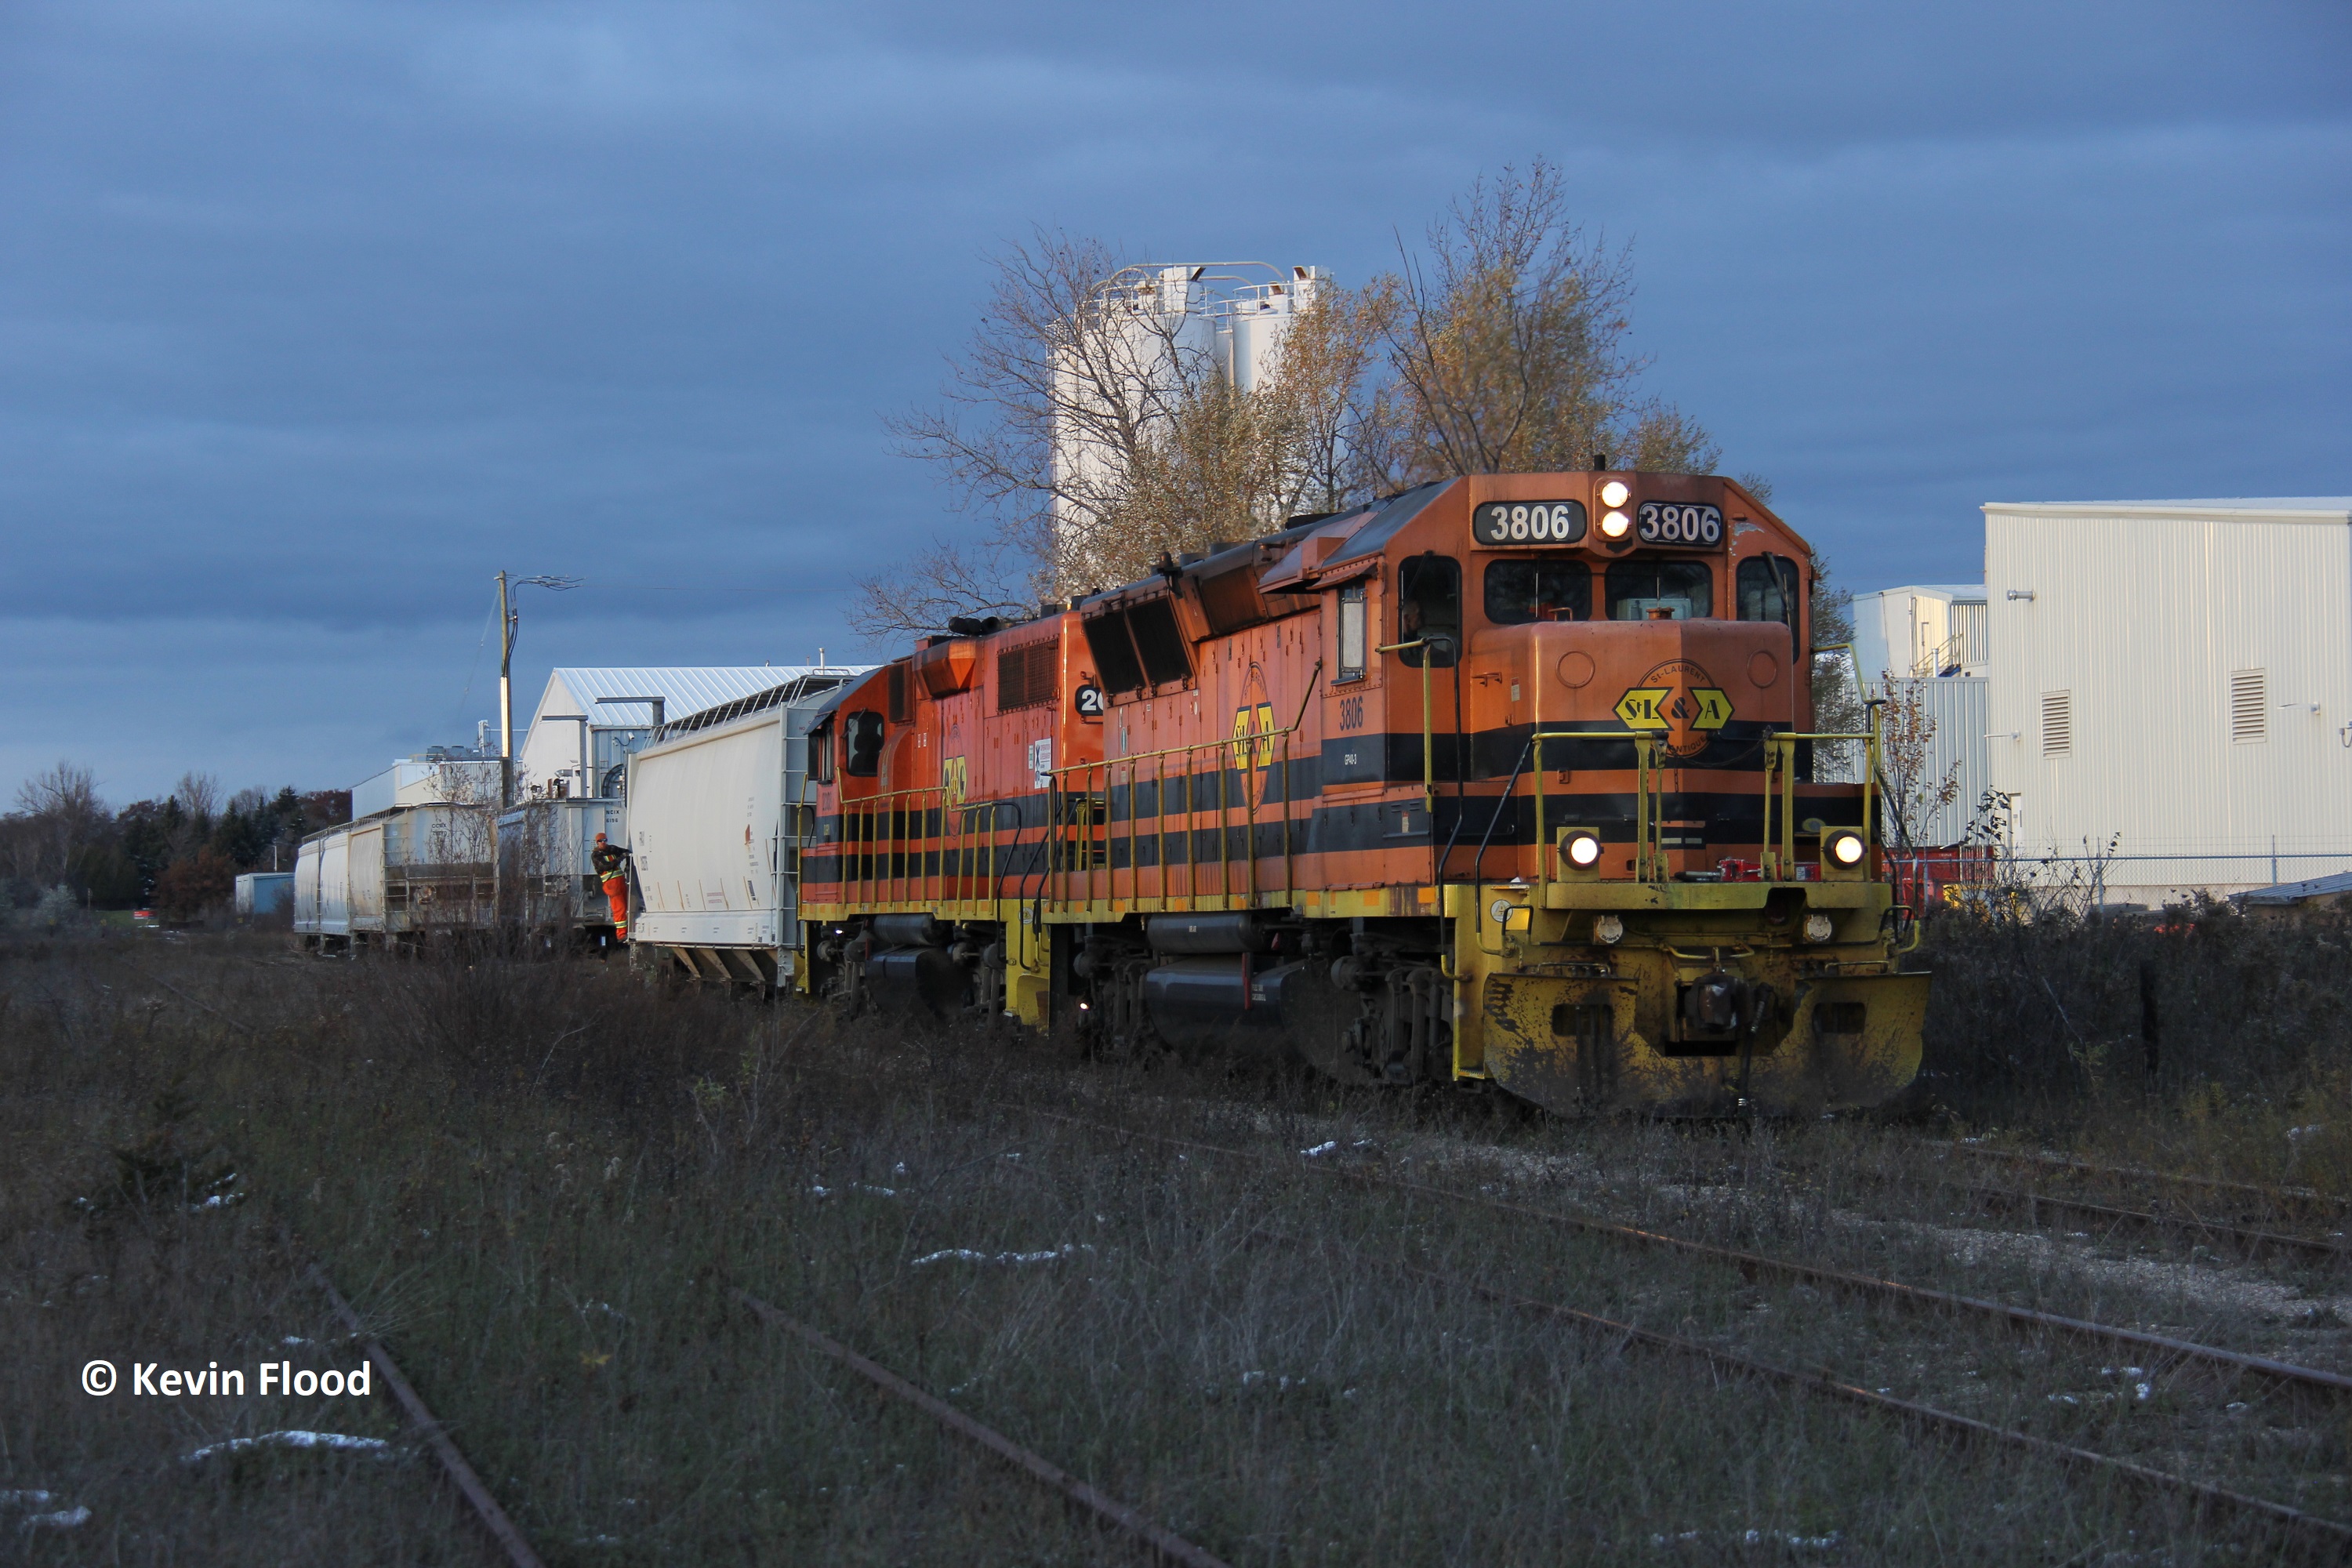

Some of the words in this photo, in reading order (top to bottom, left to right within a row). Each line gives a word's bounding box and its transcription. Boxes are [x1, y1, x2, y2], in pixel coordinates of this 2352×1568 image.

[1490, 505, 1569, 540] 3806
[1641, 506, 1720, 542] 3806
[1650, 665, 1705, 683] St-LAURENT
[1339, 695, 1363, 731] 3806
[1671, 696, 1690, 719] &
[1704, 699, 1721, 720] A
